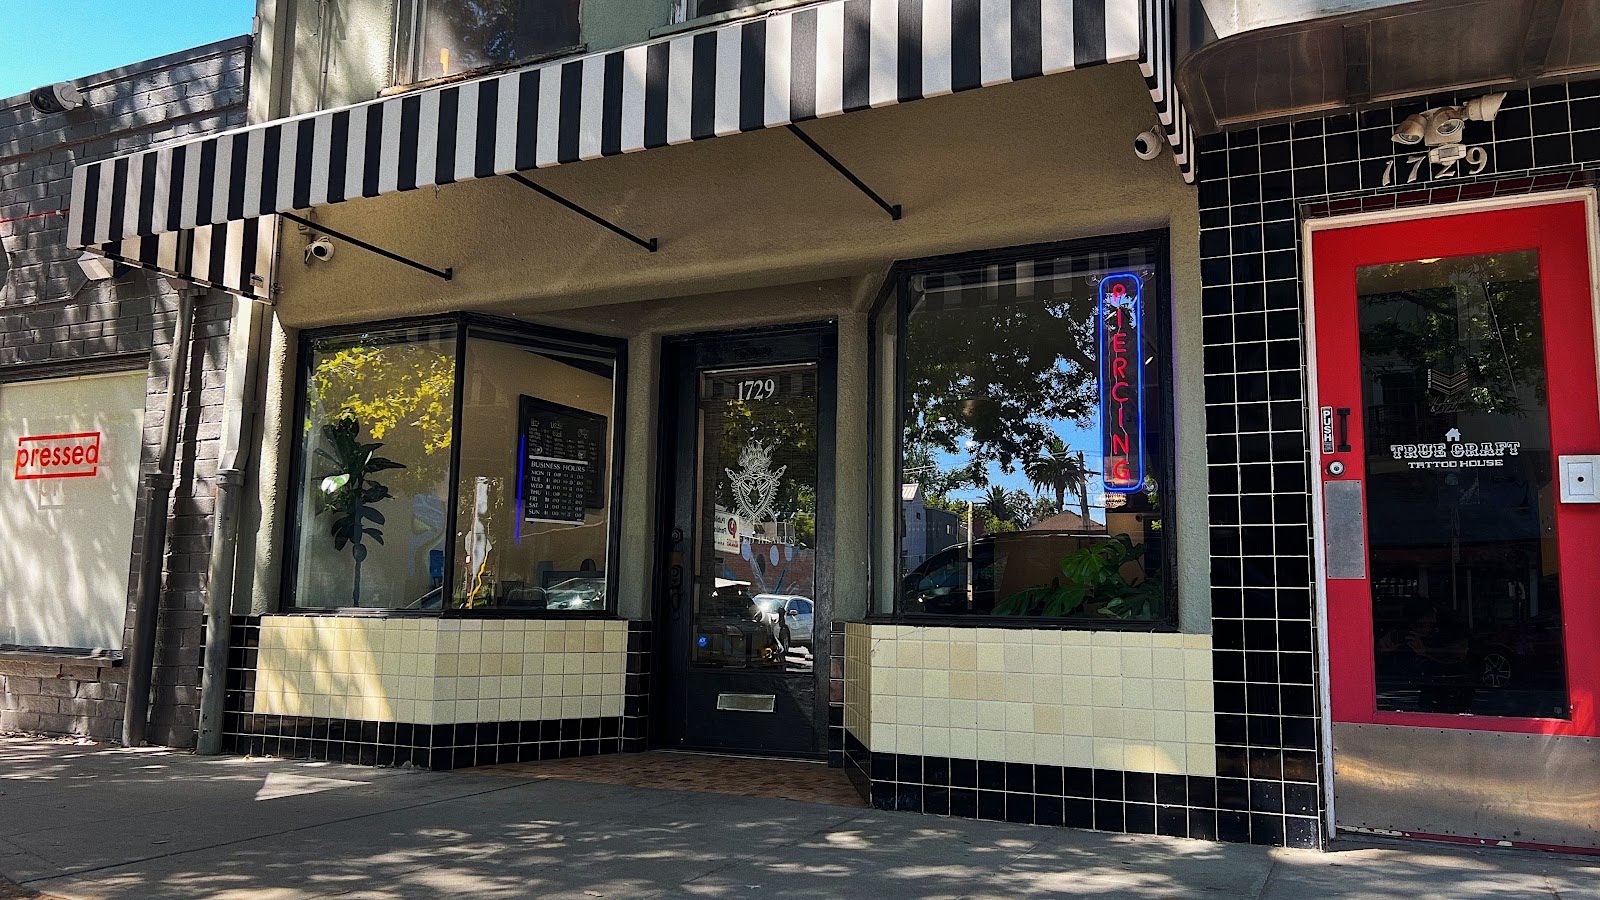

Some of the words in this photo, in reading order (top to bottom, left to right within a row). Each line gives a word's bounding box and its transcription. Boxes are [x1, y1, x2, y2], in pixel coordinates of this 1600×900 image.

[737, 378, 775, 401] 1729
[1112, 283, 1131, 480] PIERCING
[1323, 410, 1332, 442] PUSH
[16, 444, 98, 469] pressed
[1390, 443, 1447, 459] TRUE
[1450, 441, 1521, 458] CRAFT
[530, 461, 561, 470] BUSINESS
[562, 464, 586, 473] HOURS
[1407, 459, 1457, 469] TATTOO
[1459, 458, 1504, 468] HOUSE
